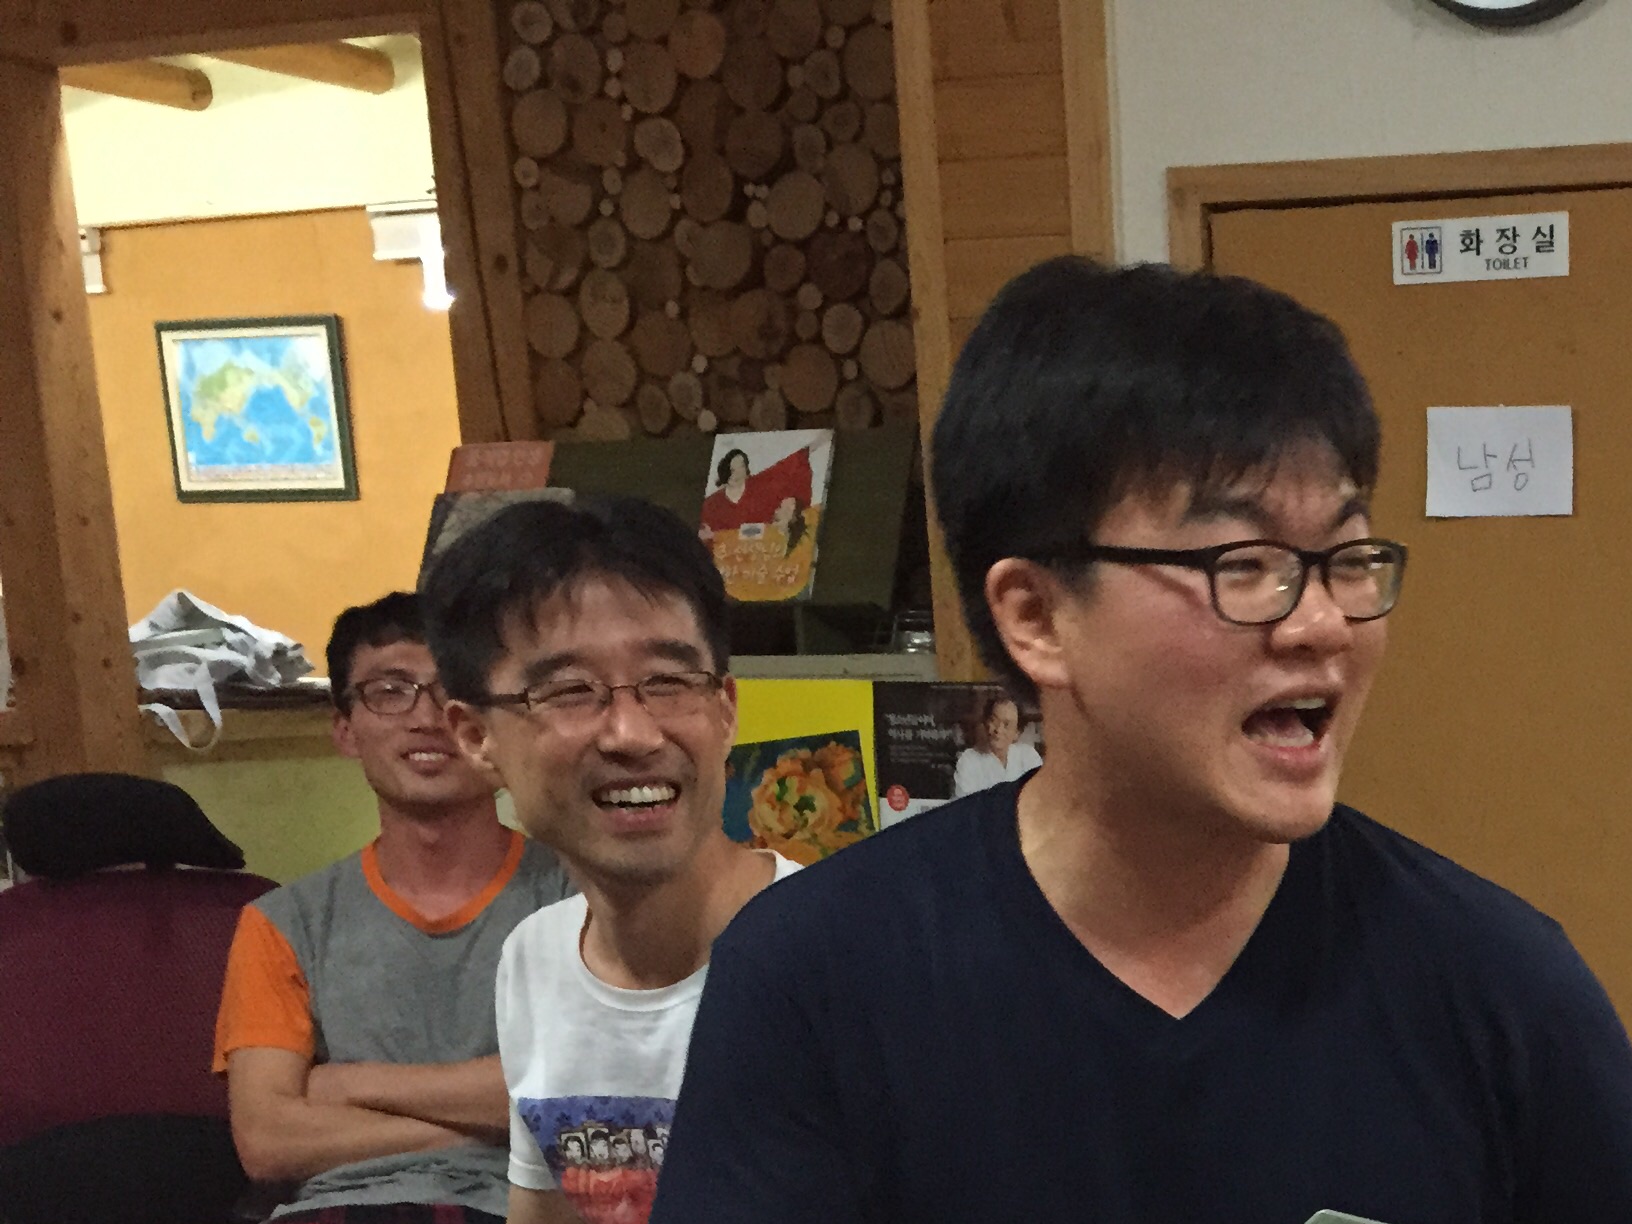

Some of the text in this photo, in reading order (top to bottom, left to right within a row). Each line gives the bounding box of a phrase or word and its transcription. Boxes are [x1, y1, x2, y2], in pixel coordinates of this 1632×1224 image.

[1459, 224, 1556, 256] 화장실
[1484, 256, 1530, 272] TOILET
[1456, 437, 1536, 493] 남성
